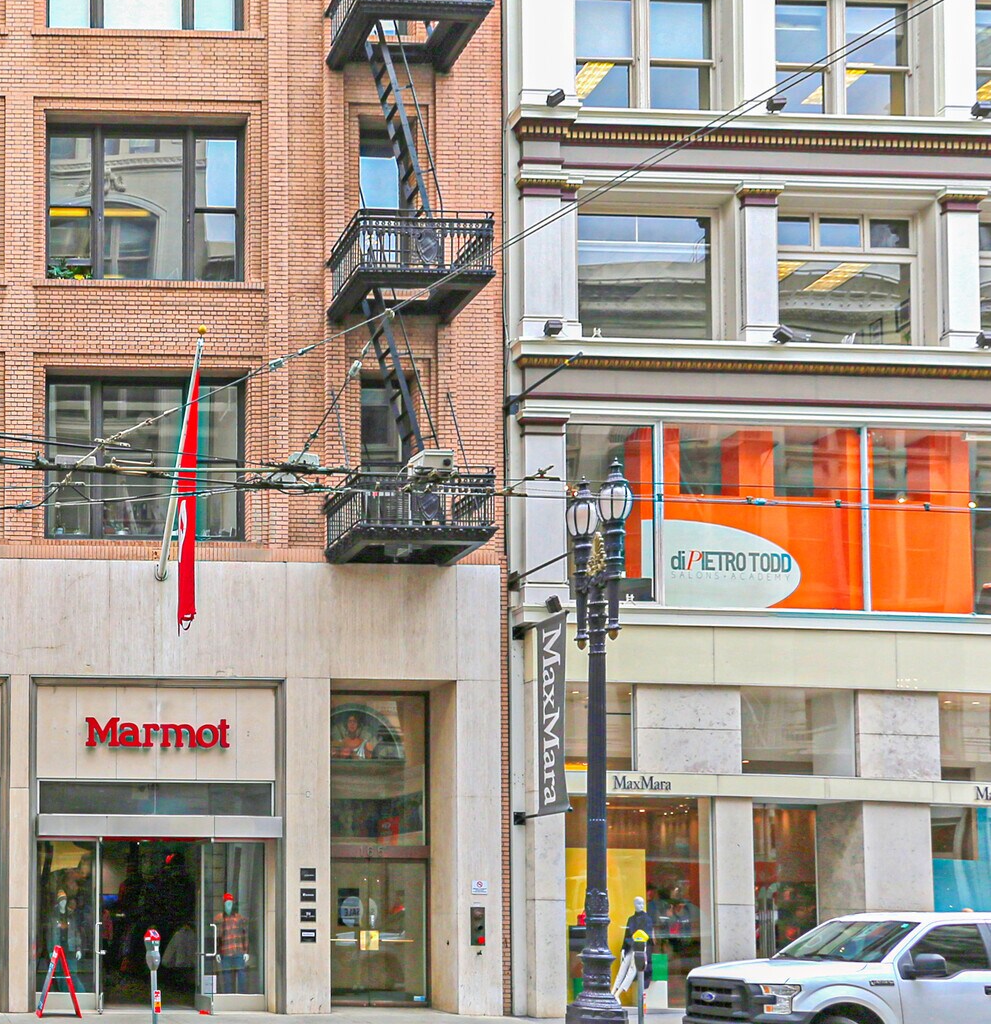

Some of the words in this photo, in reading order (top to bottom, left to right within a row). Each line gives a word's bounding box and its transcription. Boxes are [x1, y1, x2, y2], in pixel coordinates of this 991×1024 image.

[749, 552, 792, 573] TODD
[671, 570, 721, 580] SALONS
[731, 572, 791, 582] ACADEMY
[542, 623, 562, 806] MaxMara
[85, 717, 230, 748] Marmot
[612, 775, 672, 791] MaxMara
